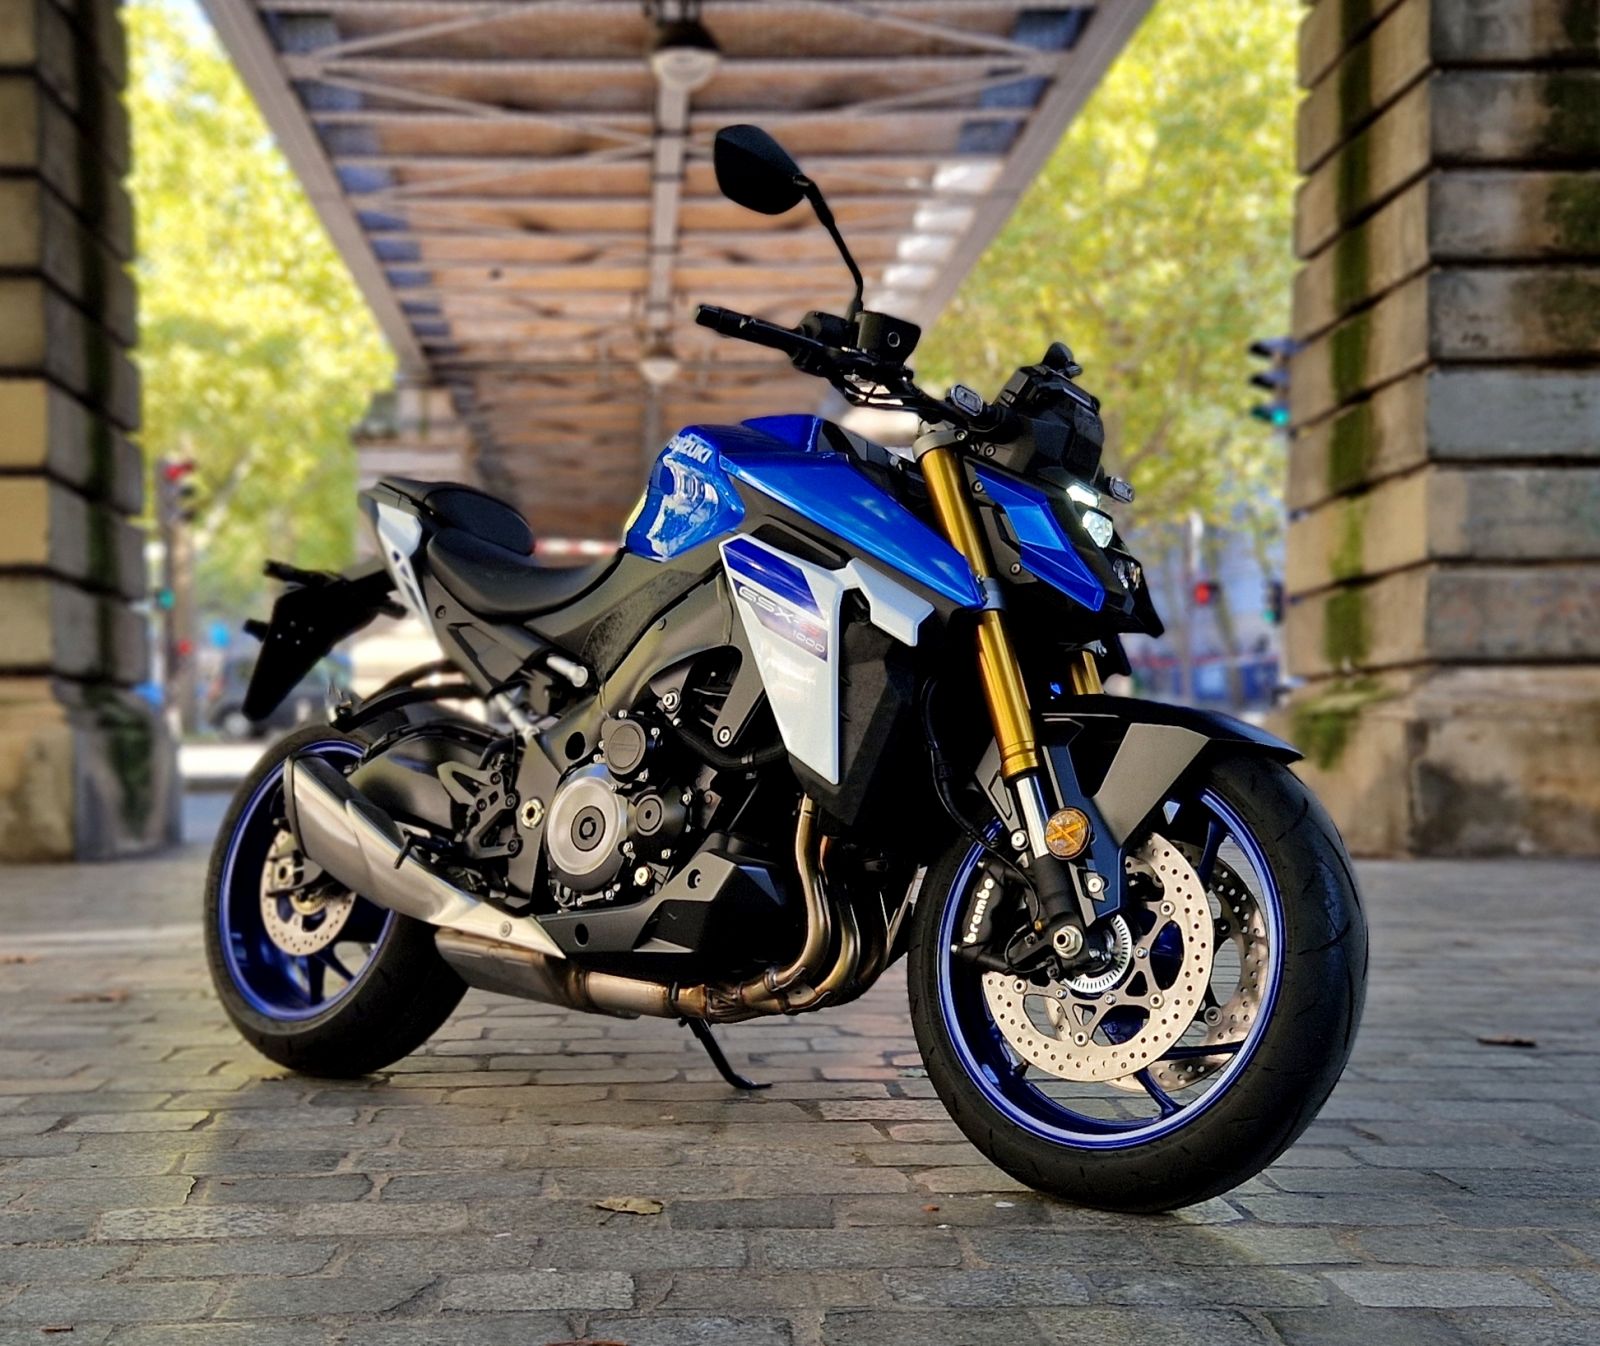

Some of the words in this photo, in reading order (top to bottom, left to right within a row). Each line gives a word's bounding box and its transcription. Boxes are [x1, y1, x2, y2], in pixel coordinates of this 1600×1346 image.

[668, 433, 713, 464] SUZUKI
[792, 629, 825, 653] 1000
[963, 878, 995, 944] brembo
